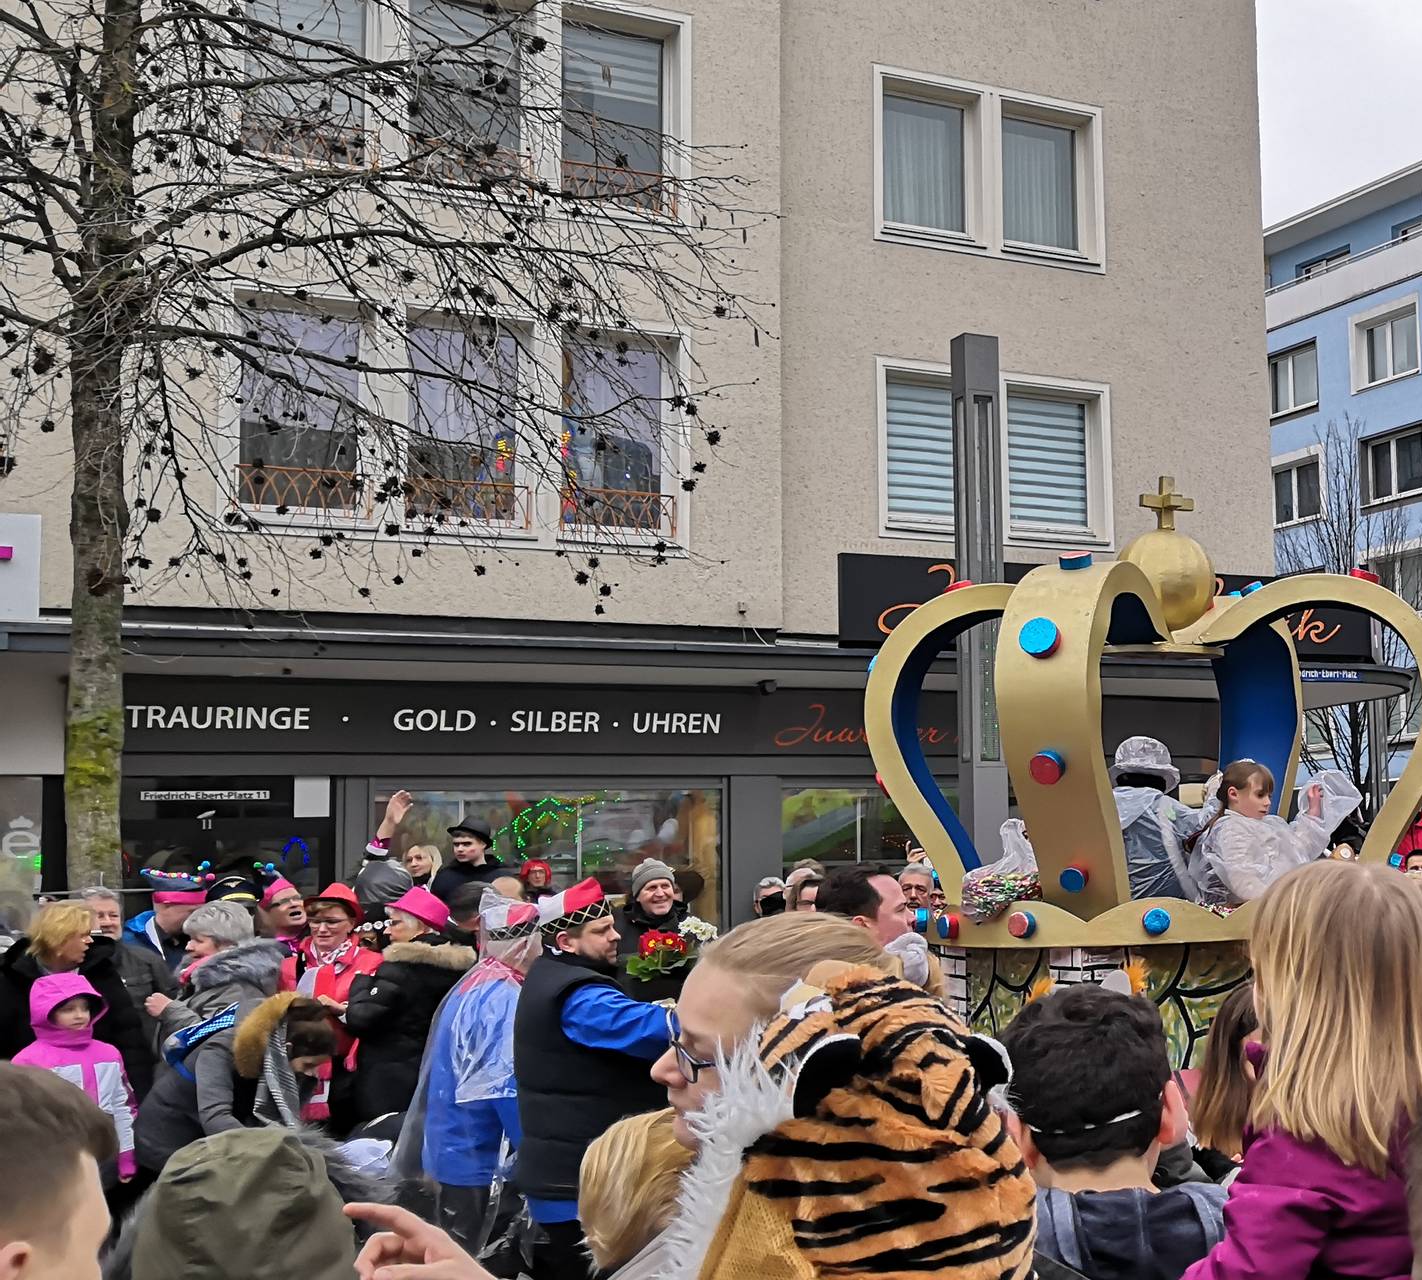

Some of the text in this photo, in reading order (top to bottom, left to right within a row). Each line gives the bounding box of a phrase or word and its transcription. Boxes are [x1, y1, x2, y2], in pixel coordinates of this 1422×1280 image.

[1299, 669, 1358, 679] drich-Ebert-Platz
[126, 705, 721, 734] TRAURINGE GOLD SILBER UHREN
[143, 791, 268, 800] Friedrich-Ebert-Platz 11
